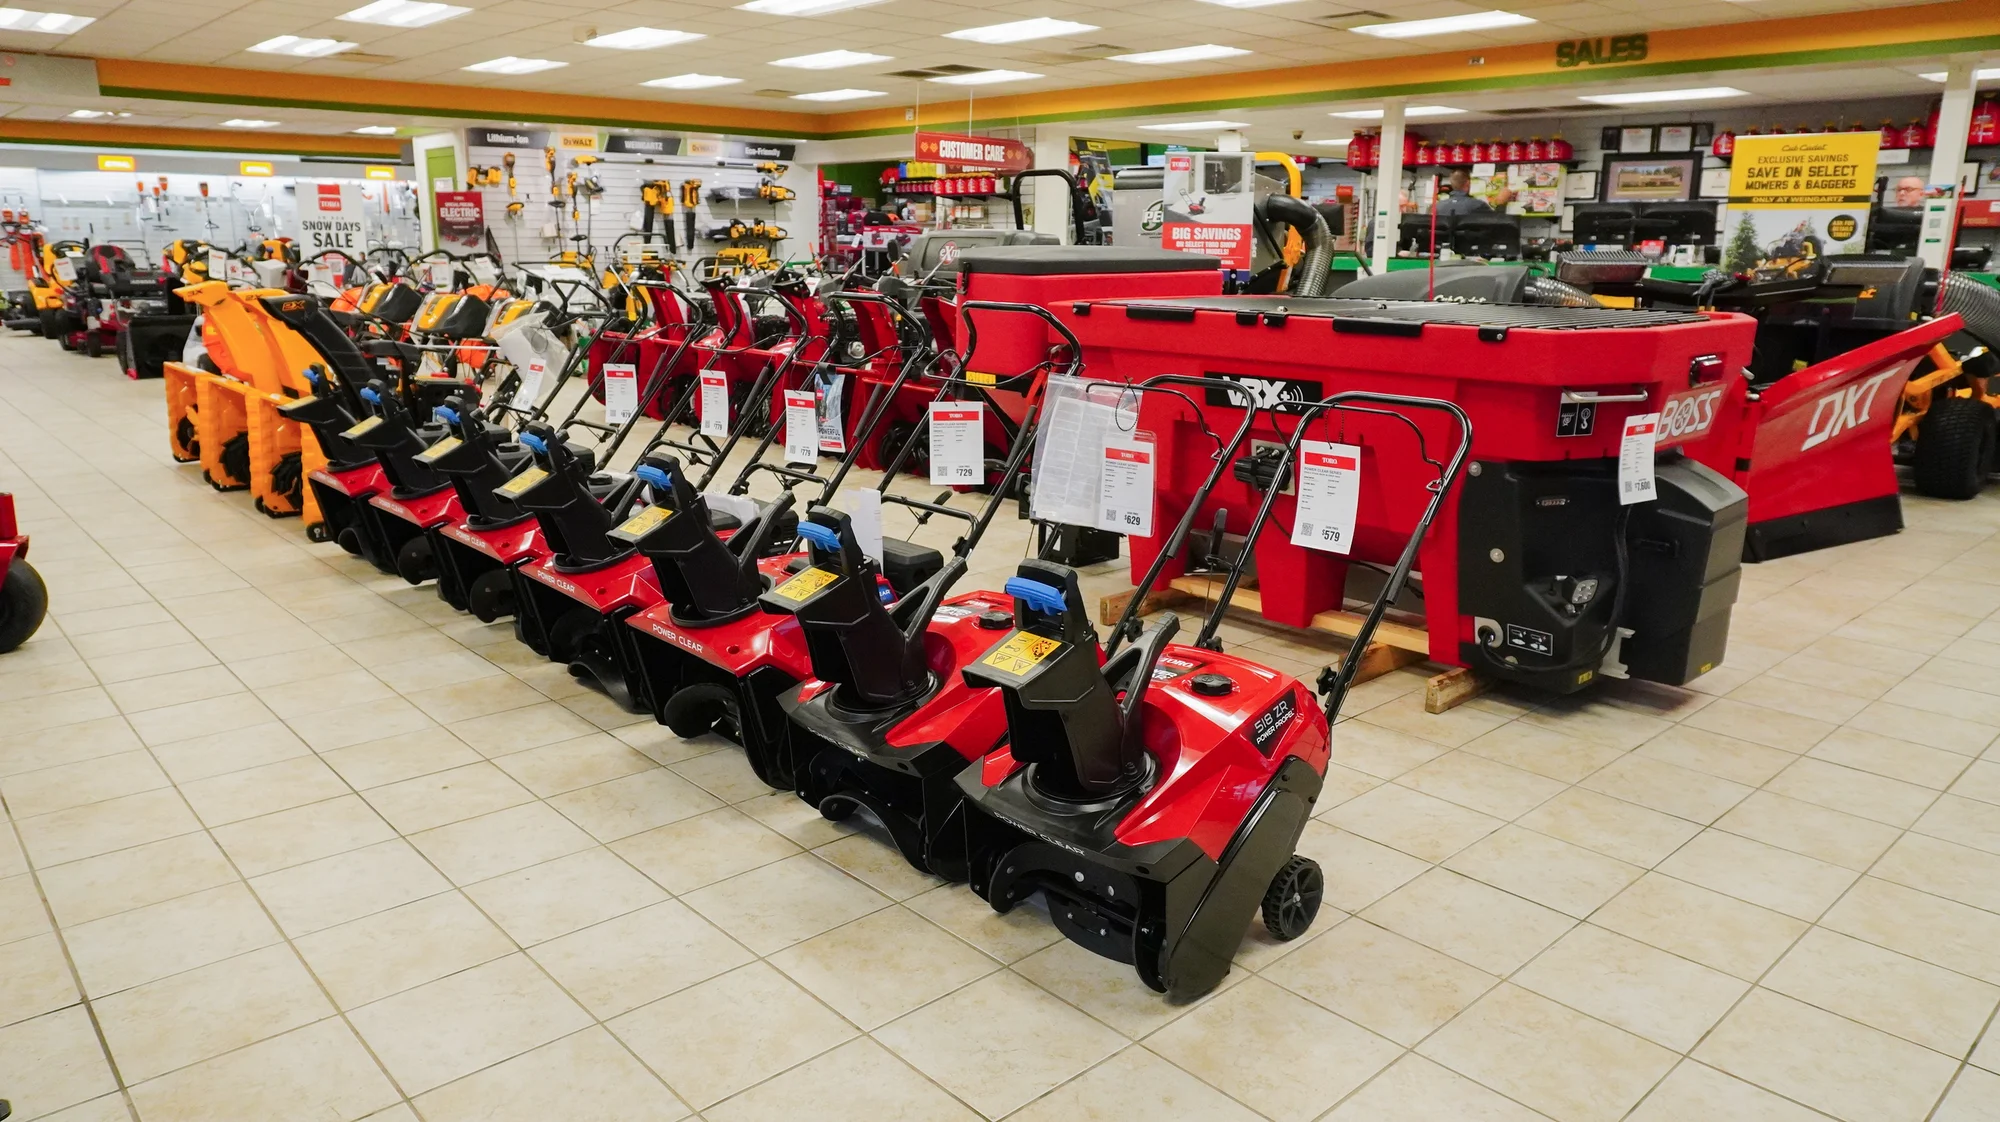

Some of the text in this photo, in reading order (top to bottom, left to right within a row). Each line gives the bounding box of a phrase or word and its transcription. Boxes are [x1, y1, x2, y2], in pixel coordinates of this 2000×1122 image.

[1556, 33, 1648, 67] SALES
[486, 133, 529, 144] Lithium-Ion
[939, 140, 1005, 162] CUSTOMER CARE
[1758, 154, 1849, 164] EXCLUSIVE SAVINGS
[1747, 165, 1858, 178] SAVE ON SELECT
[1745, 179, 1856, 190] MOWERS & BAGGERS
[440, 207, 480, 217] ELECTRIC
[302, 220, 361, 232] SNOW DAYS
[313, 232, 354, 248] SALE
[1172, 227, 1191, 240] BIG
[1194, 227, 1241, 241] SAVINGS
[282, 300, 305, 311] 2X
[1657, 390, 1722, 441] BOSS
[1801, 367, 1902, 452] DXT
[956, 468, 973, 477] $729
[1124, 514, 1141, 526] $629
[1321, 529, 1341, 542] $579
[537, 570, 576, 594] POWER CLEAR
[652, 623, 703, 654] POWER CLEAR
[1254, 700, 1289, 734] 518 ZR
[1256, 725, 1276, 745] POWER
